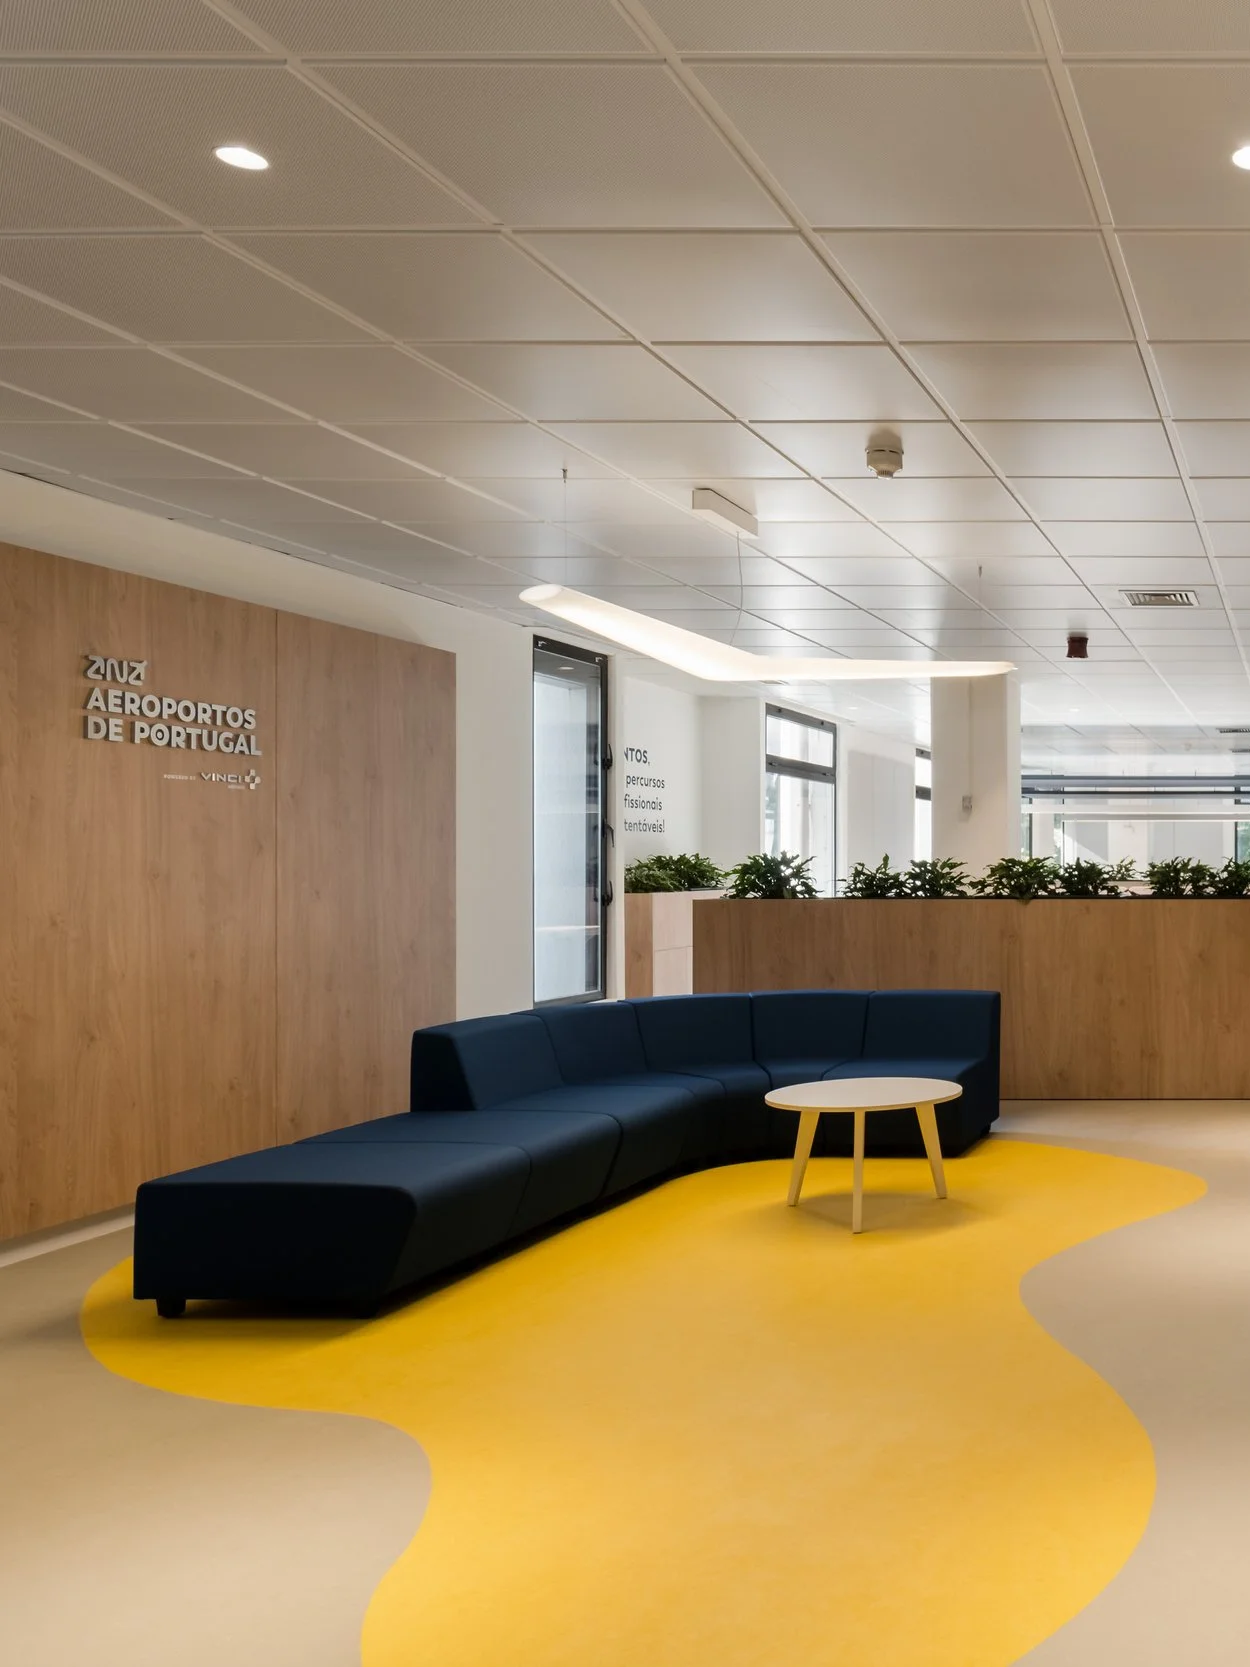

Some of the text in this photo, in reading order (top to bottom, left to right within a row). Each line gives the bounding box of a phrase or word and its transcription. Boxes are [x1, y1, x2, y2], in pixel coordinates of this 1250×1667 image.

[86, 687, 256, 730] AEROPORTOS
[87, 716, 262, 756] DE PORTUGAL
[201, 771, 242, 783] VINCI
[626, 775, 665, 789] percursos
[624, 794, 662, 811] fissionais
[624, 819, 665, 833] tentáveis!
